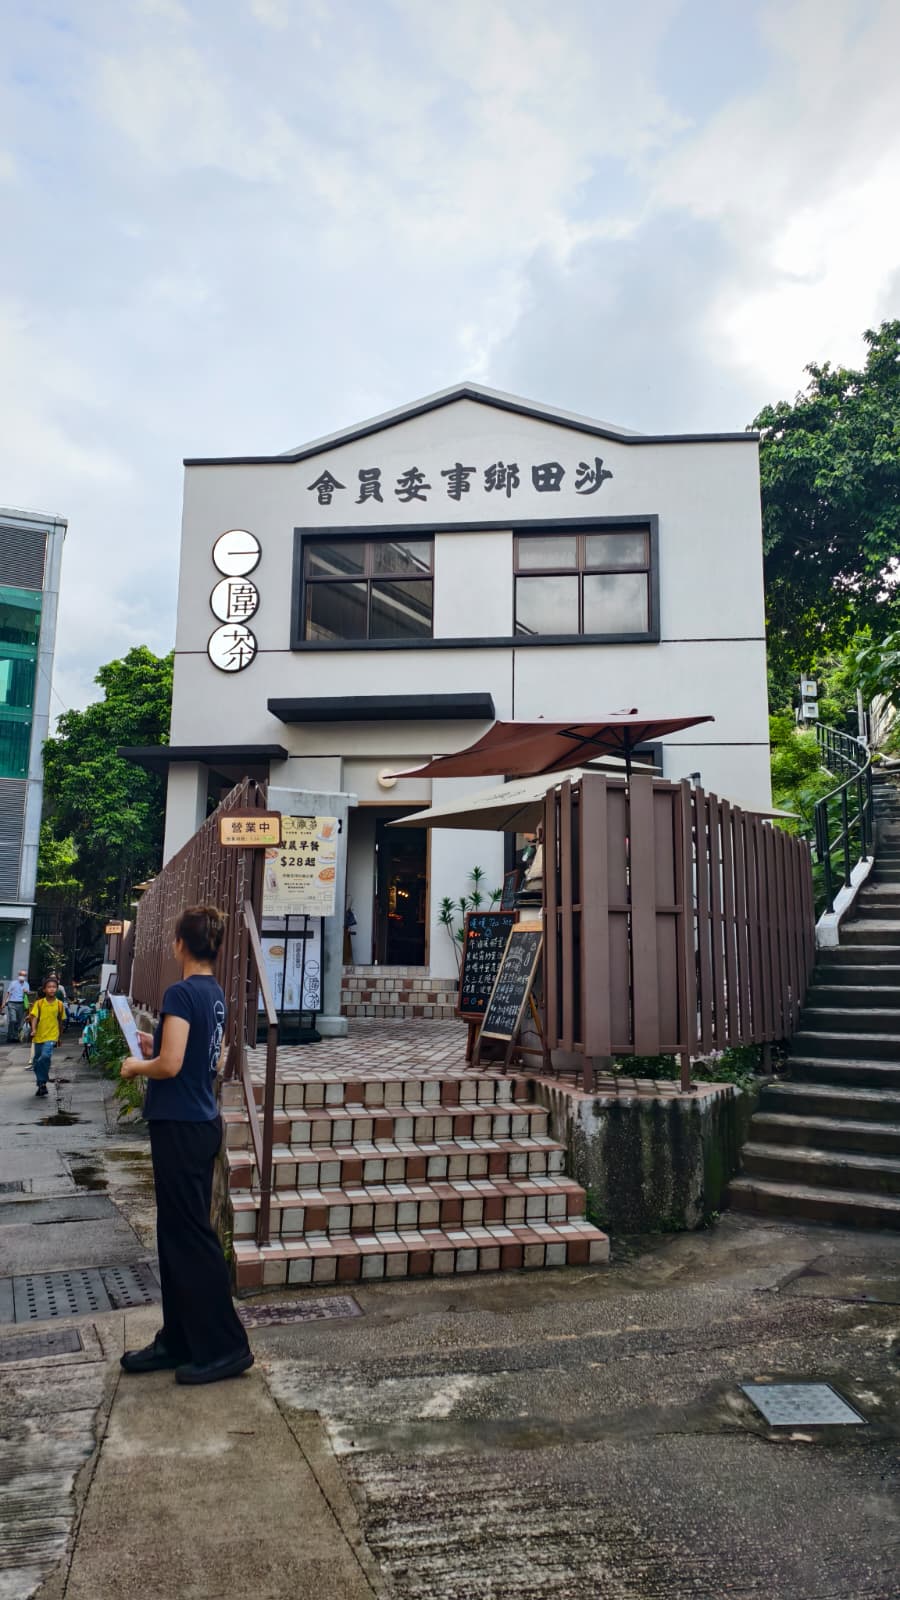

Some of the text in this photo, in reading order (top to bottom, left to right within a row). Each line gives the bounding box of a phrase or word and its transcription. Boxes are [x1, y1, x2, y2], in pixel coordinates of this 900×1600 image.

[232, 822, 269, 833] 營業中
[280, 855, 316, 867] $28起
